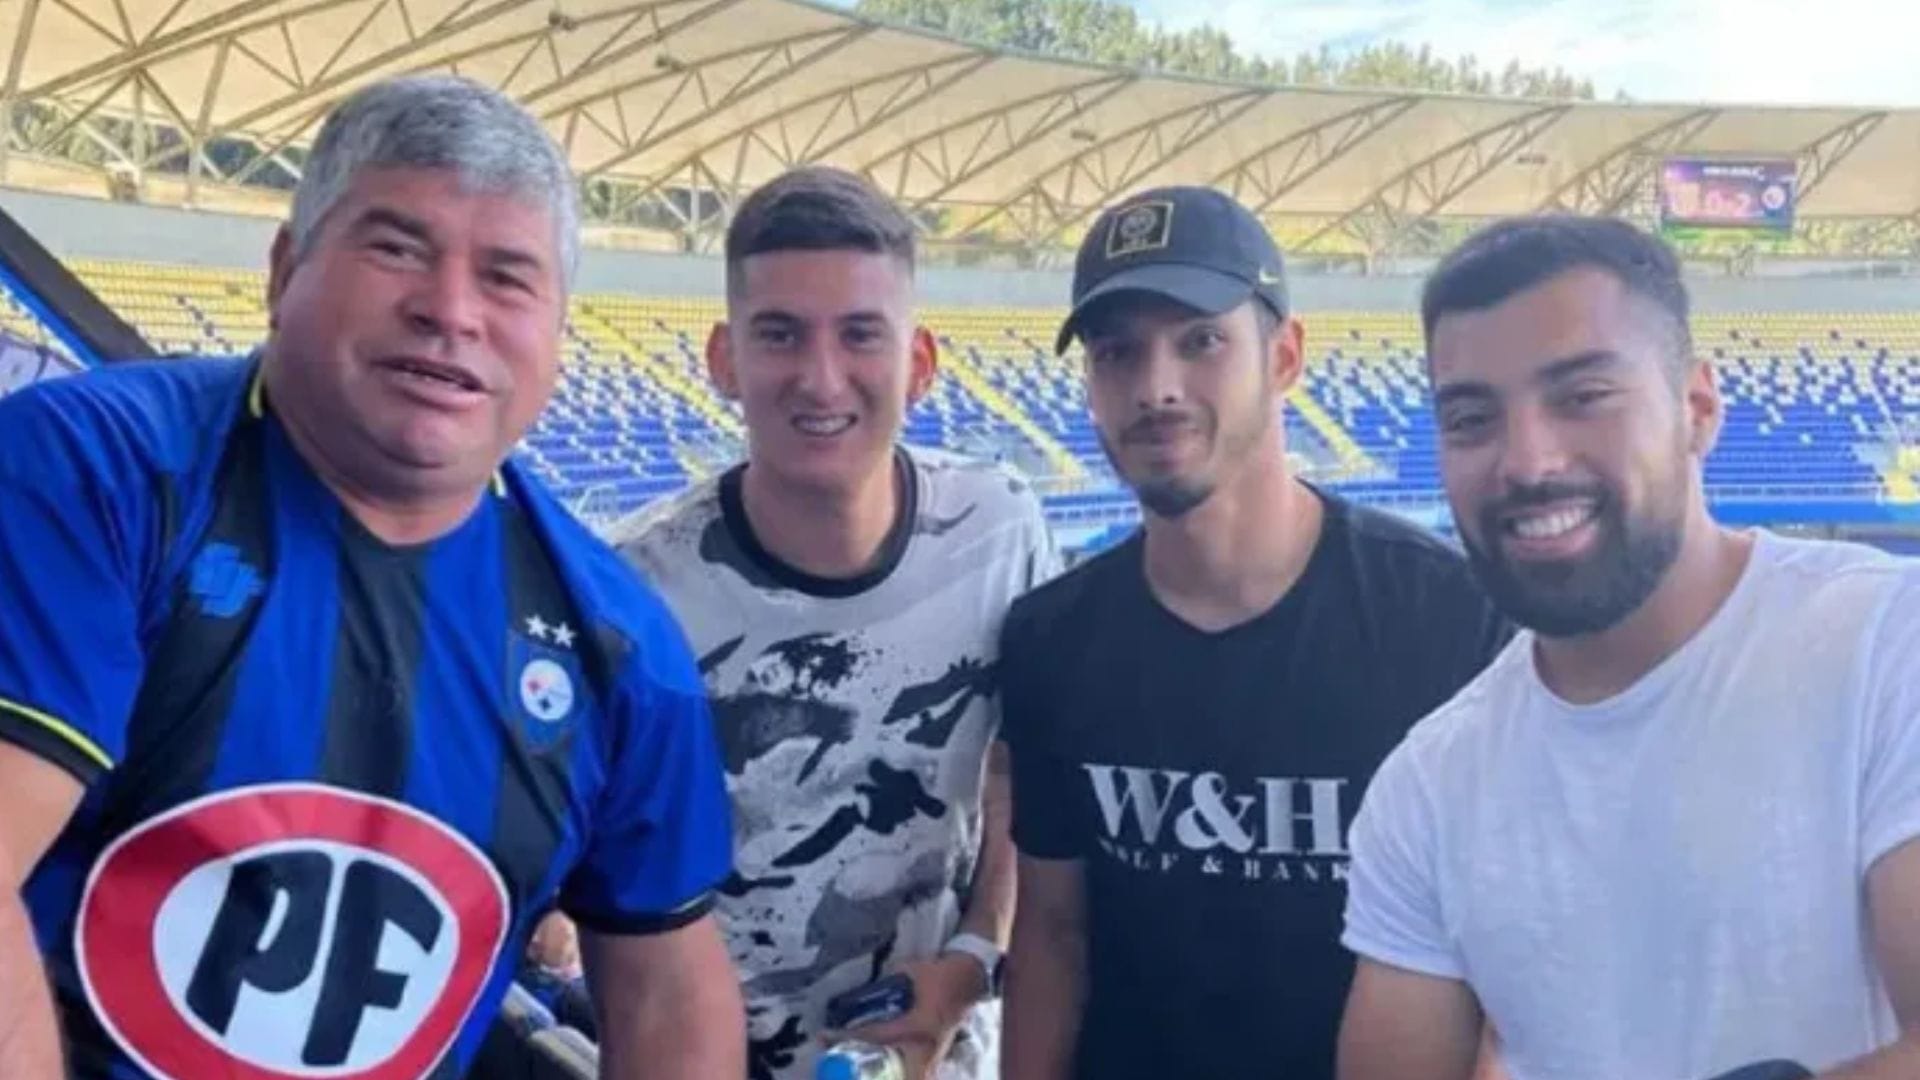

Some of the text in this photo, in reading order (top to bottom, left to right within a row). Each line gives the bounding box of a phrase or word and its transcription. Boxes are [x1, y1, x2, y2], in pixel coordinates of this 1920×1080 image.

[1081, 763, 1350, 855] W&H
[1202, 854, 1223, 874] &
[185, 849, 444, 1067] PF
